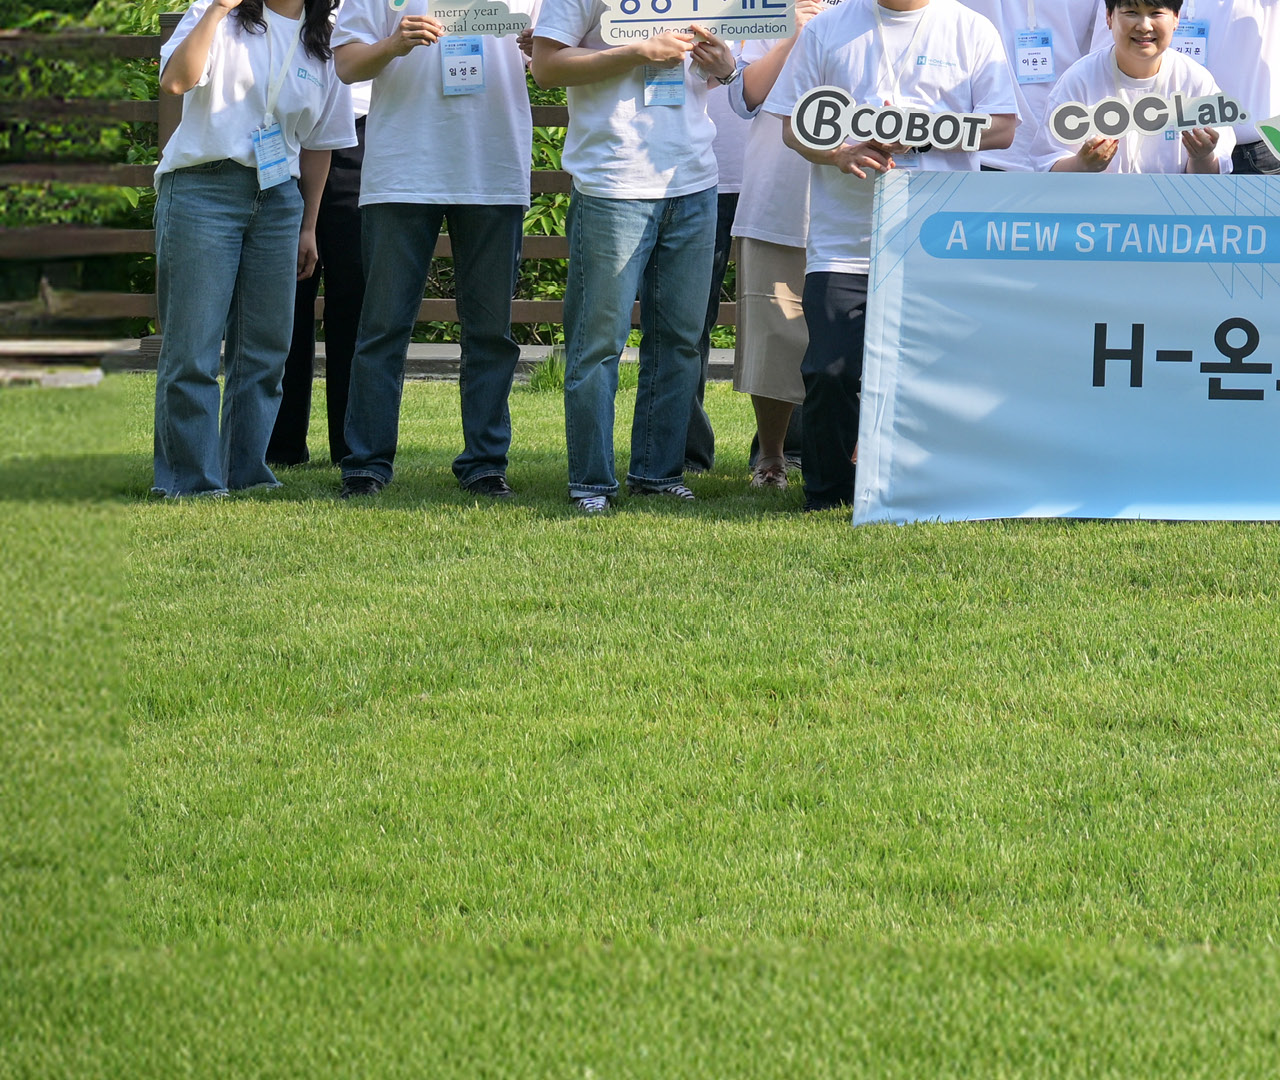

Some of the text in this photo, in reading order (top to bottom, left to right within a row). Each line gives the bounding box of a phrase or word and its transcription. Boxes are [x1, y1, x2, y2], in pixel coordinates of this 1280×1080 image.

[434, 8, 499, 20] merry year
[440, 21, 528, 34] ocial company
[610, 27, 649, 40] Chung
[721, 23, 787, 35] Foundation
[851, 108, 987, 148] COBOT
[946, 220, 968, 251] A
[987, 221, 1059, 252] NEW
[1075, 222, 1266, 255] STANDARD
